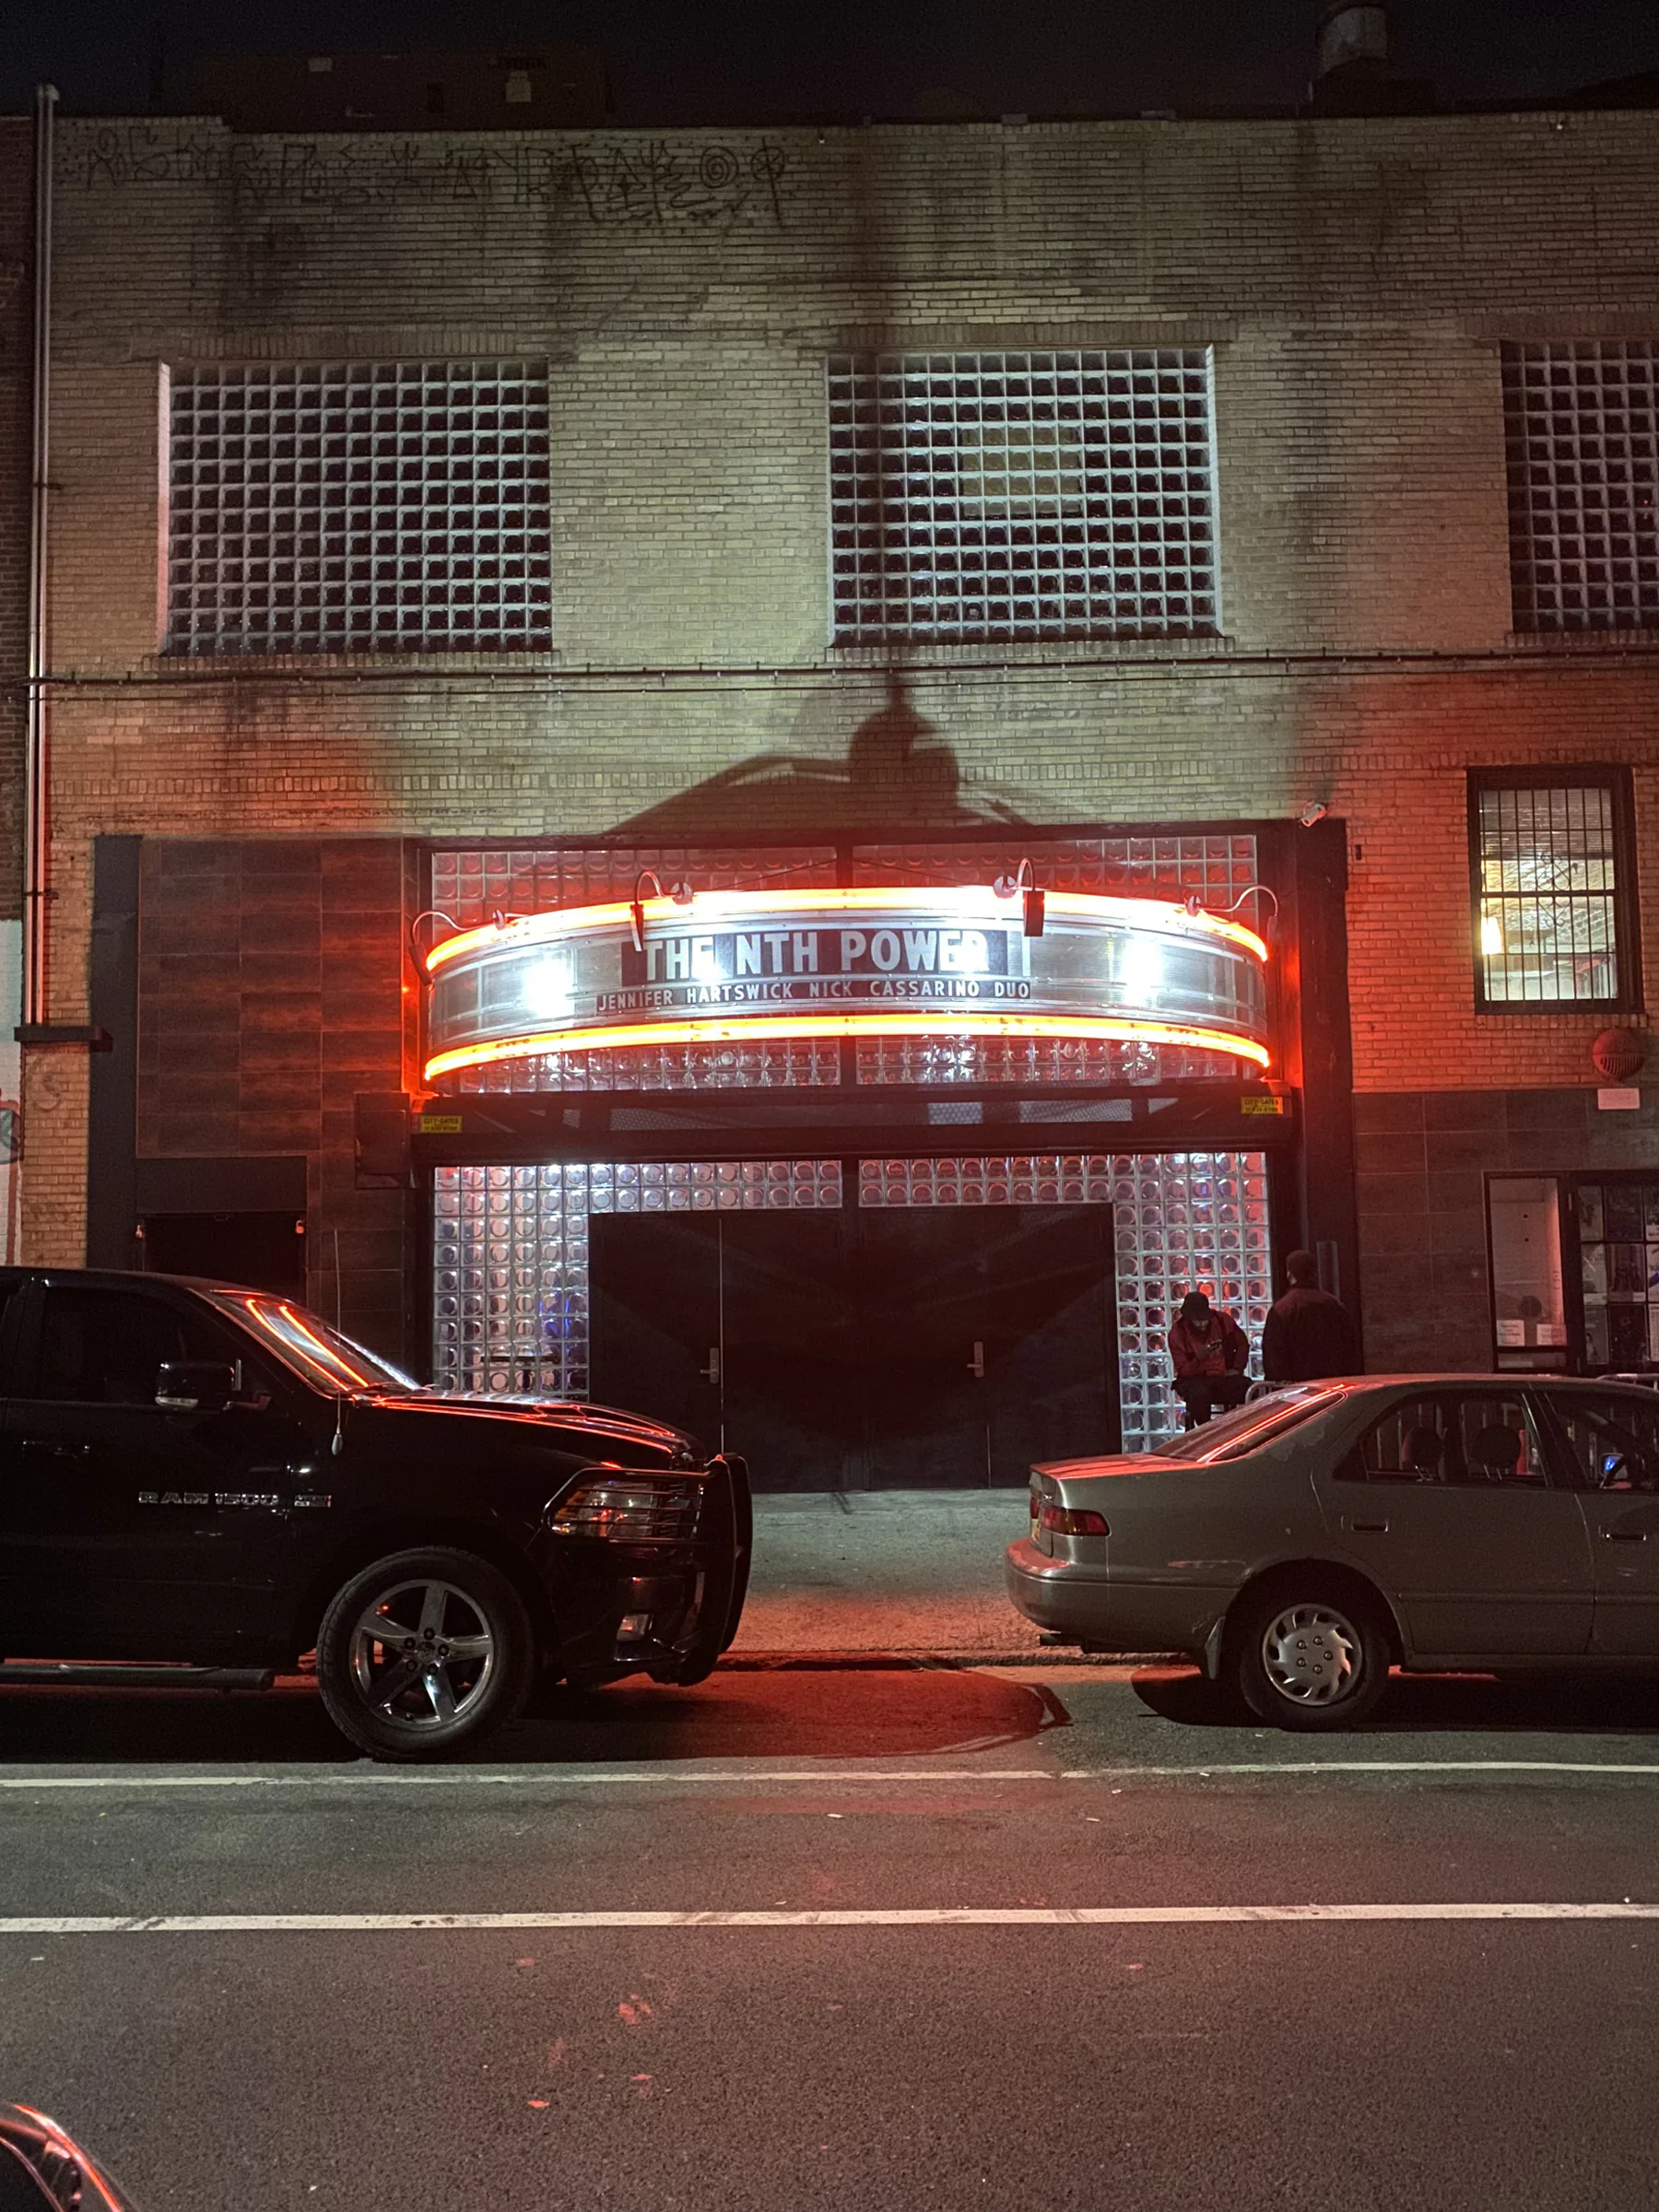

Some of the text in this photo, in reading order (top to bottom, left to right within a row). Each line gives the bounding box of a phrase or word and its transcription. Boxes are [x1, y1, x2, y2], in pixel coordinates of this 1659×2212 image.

[646, 929, 990, 982] THE NTH POWER
[599, 980, 1030, 1011] JENNIFER HARTSWICK NICK CASSARINO DUO
[138, 1491, 210, 1504] RAM
[214, 1492, 278, 1506] 1500
